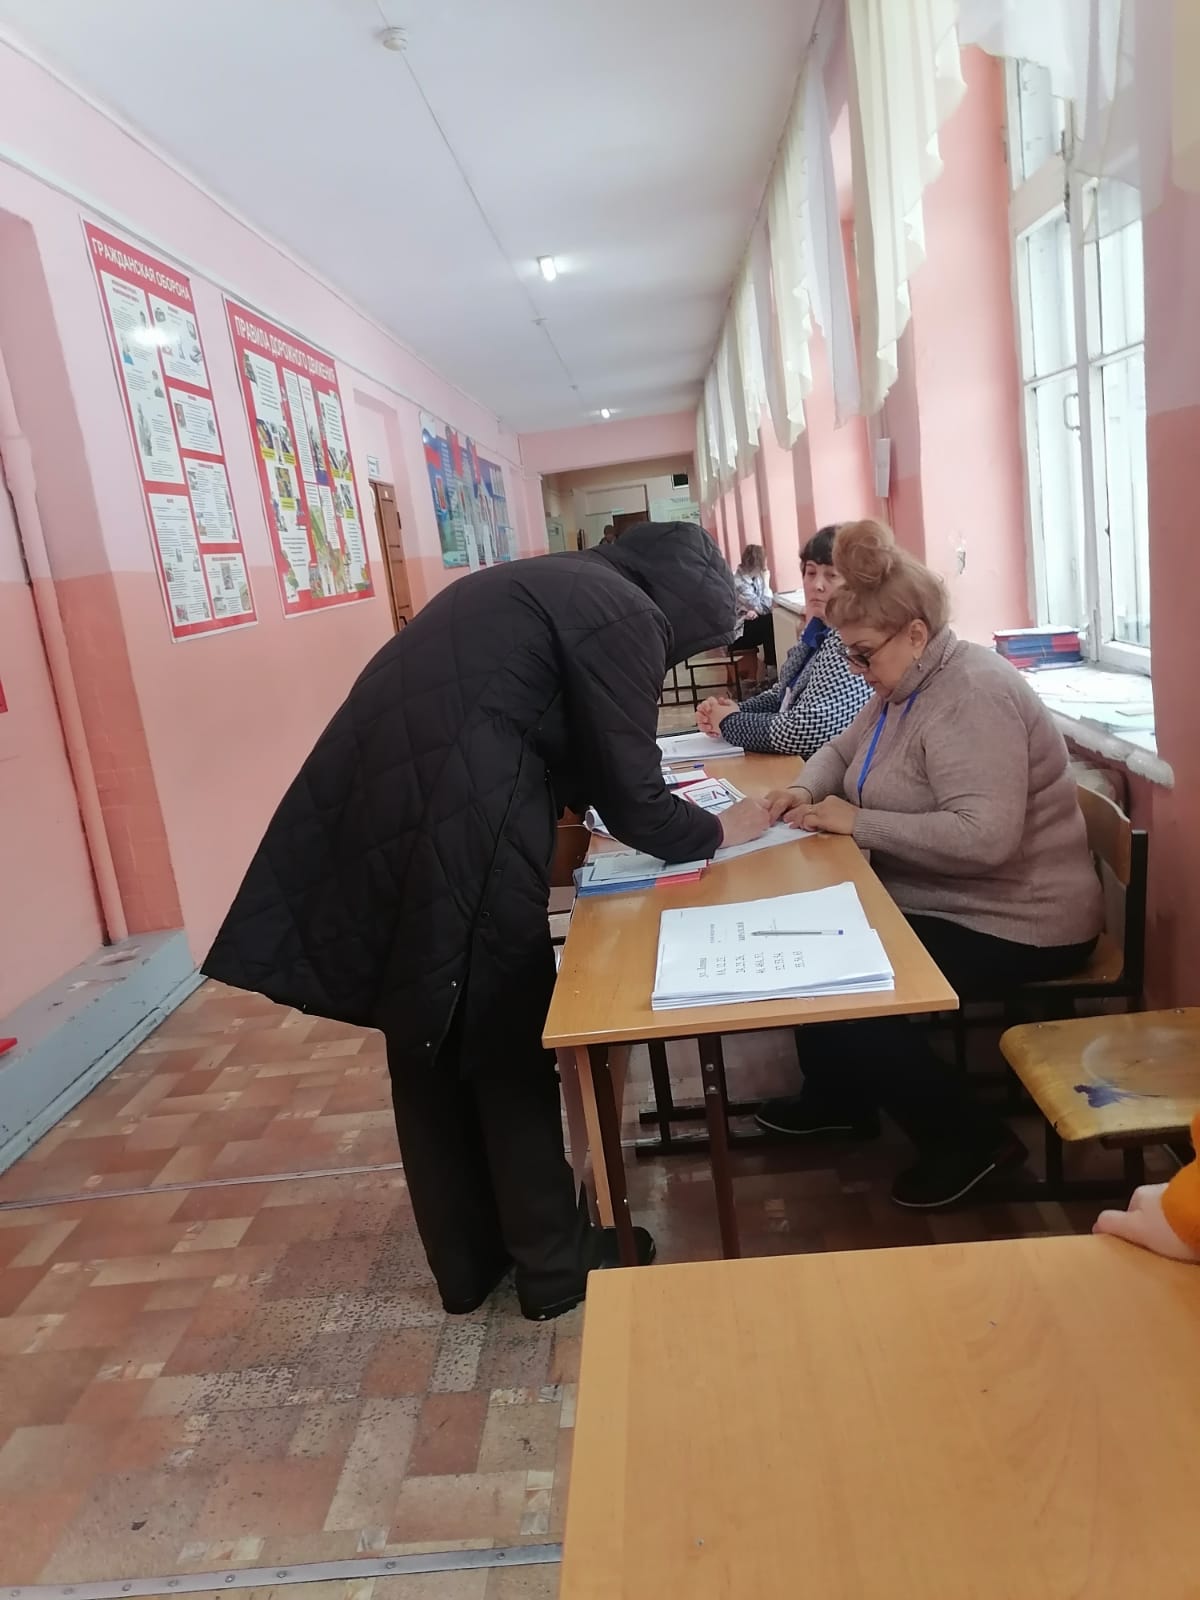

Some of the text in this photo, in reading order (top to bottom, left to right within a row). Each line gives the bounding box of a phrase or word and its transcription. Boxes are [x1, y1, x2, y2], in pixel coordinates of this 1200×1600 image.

[91, 237, 156, 284] ГРАЖДАНСКАЯ
[155, 271, 192, 302] ОБОРОНА
[234, 315, 272, 352] ПРАВИЛА
[269, 334, 309, 371] ДОРОЖНОГО
